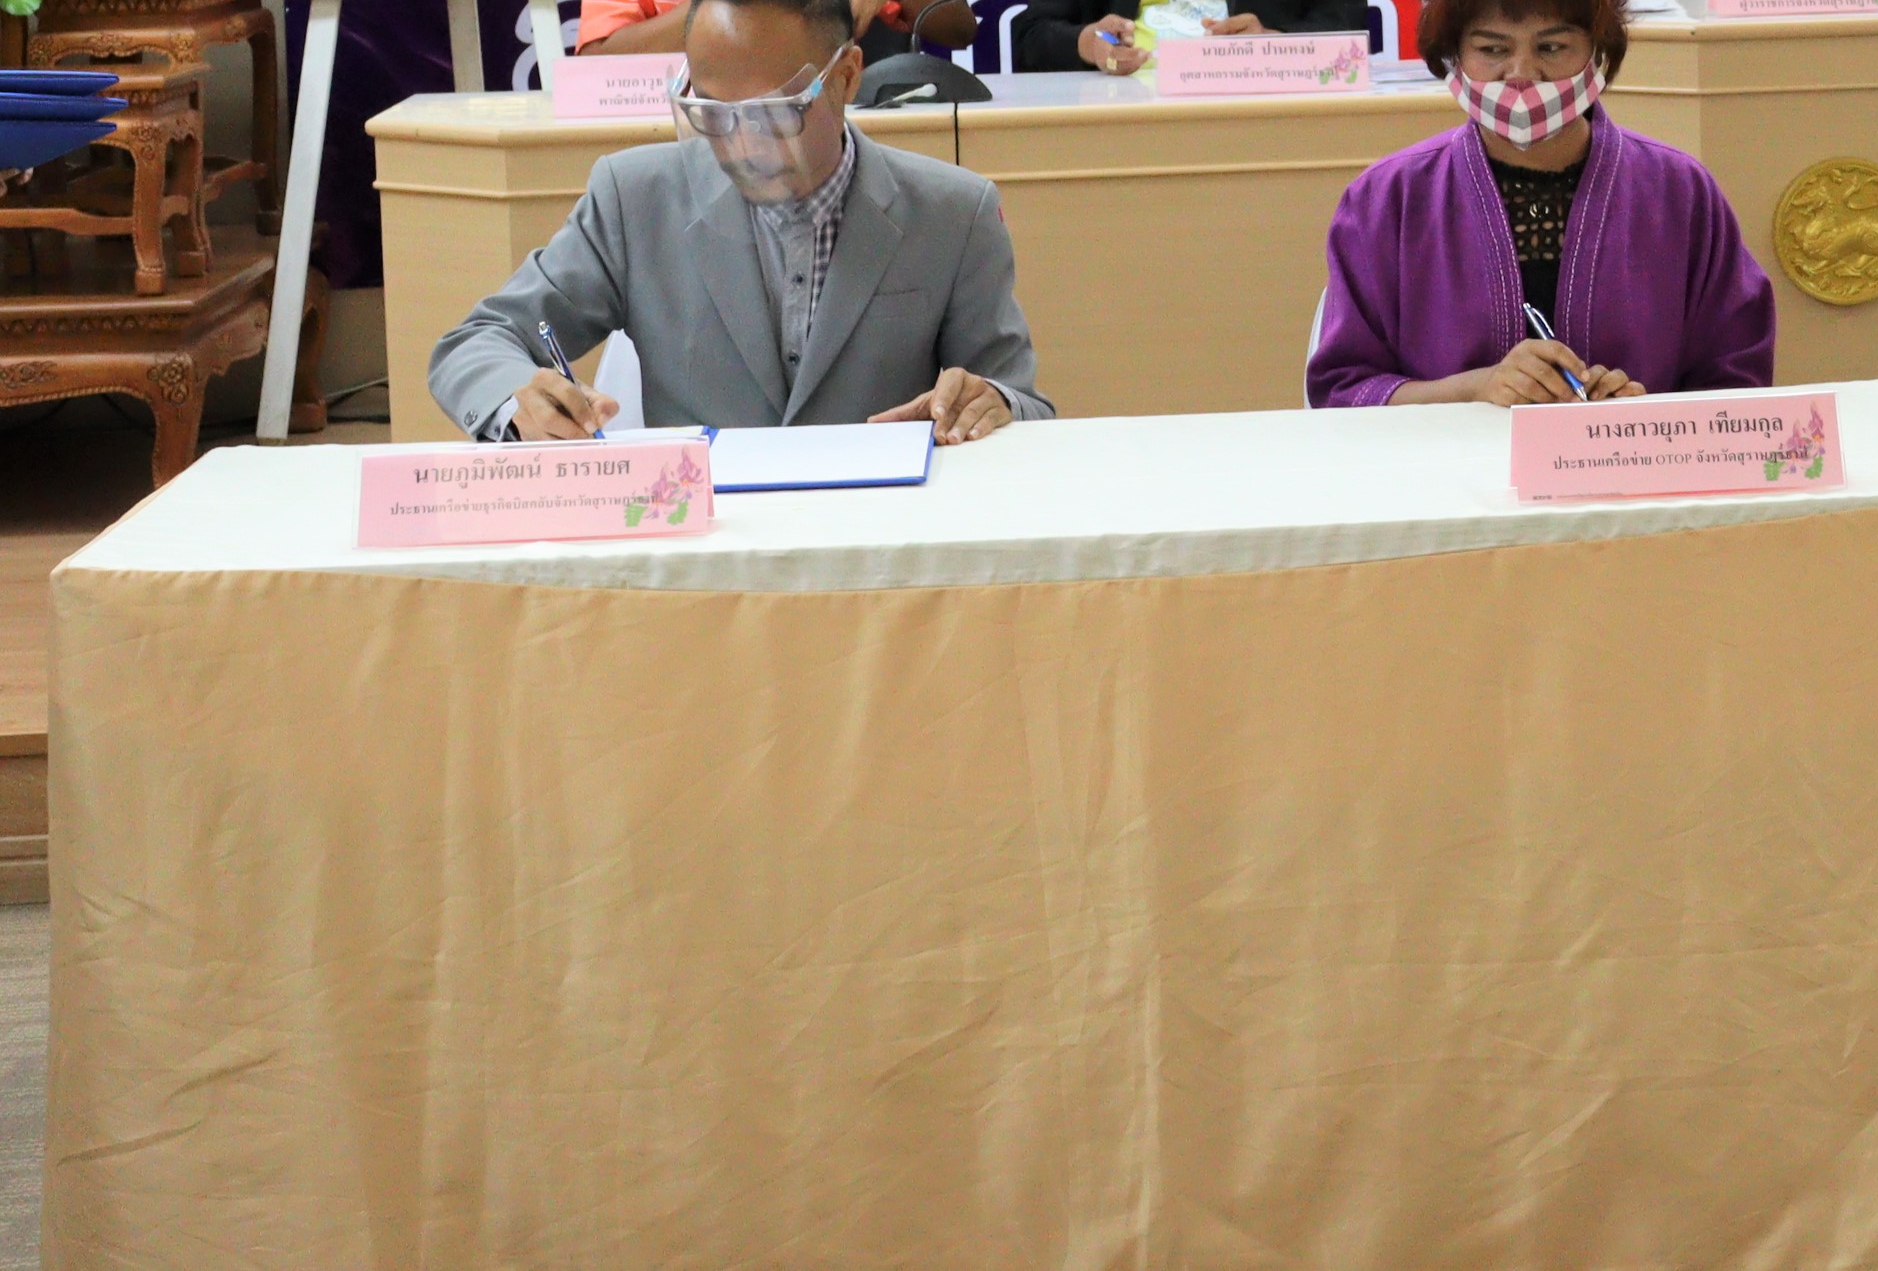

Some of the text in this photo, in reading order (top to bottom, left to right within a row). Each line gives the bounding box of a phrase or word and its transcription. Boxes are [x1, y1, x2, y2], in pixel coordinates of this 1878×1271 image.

[1586, 411, 1784, 443] นางสาวยุภา เทียมกุล
[414, 453, 631, 490] นายภูมิพัฒน์ ธารายศ
[1553, 449, 1652, 470] ประธานเครือข่าย
[1656, 453, 1692, 466] OTOP
